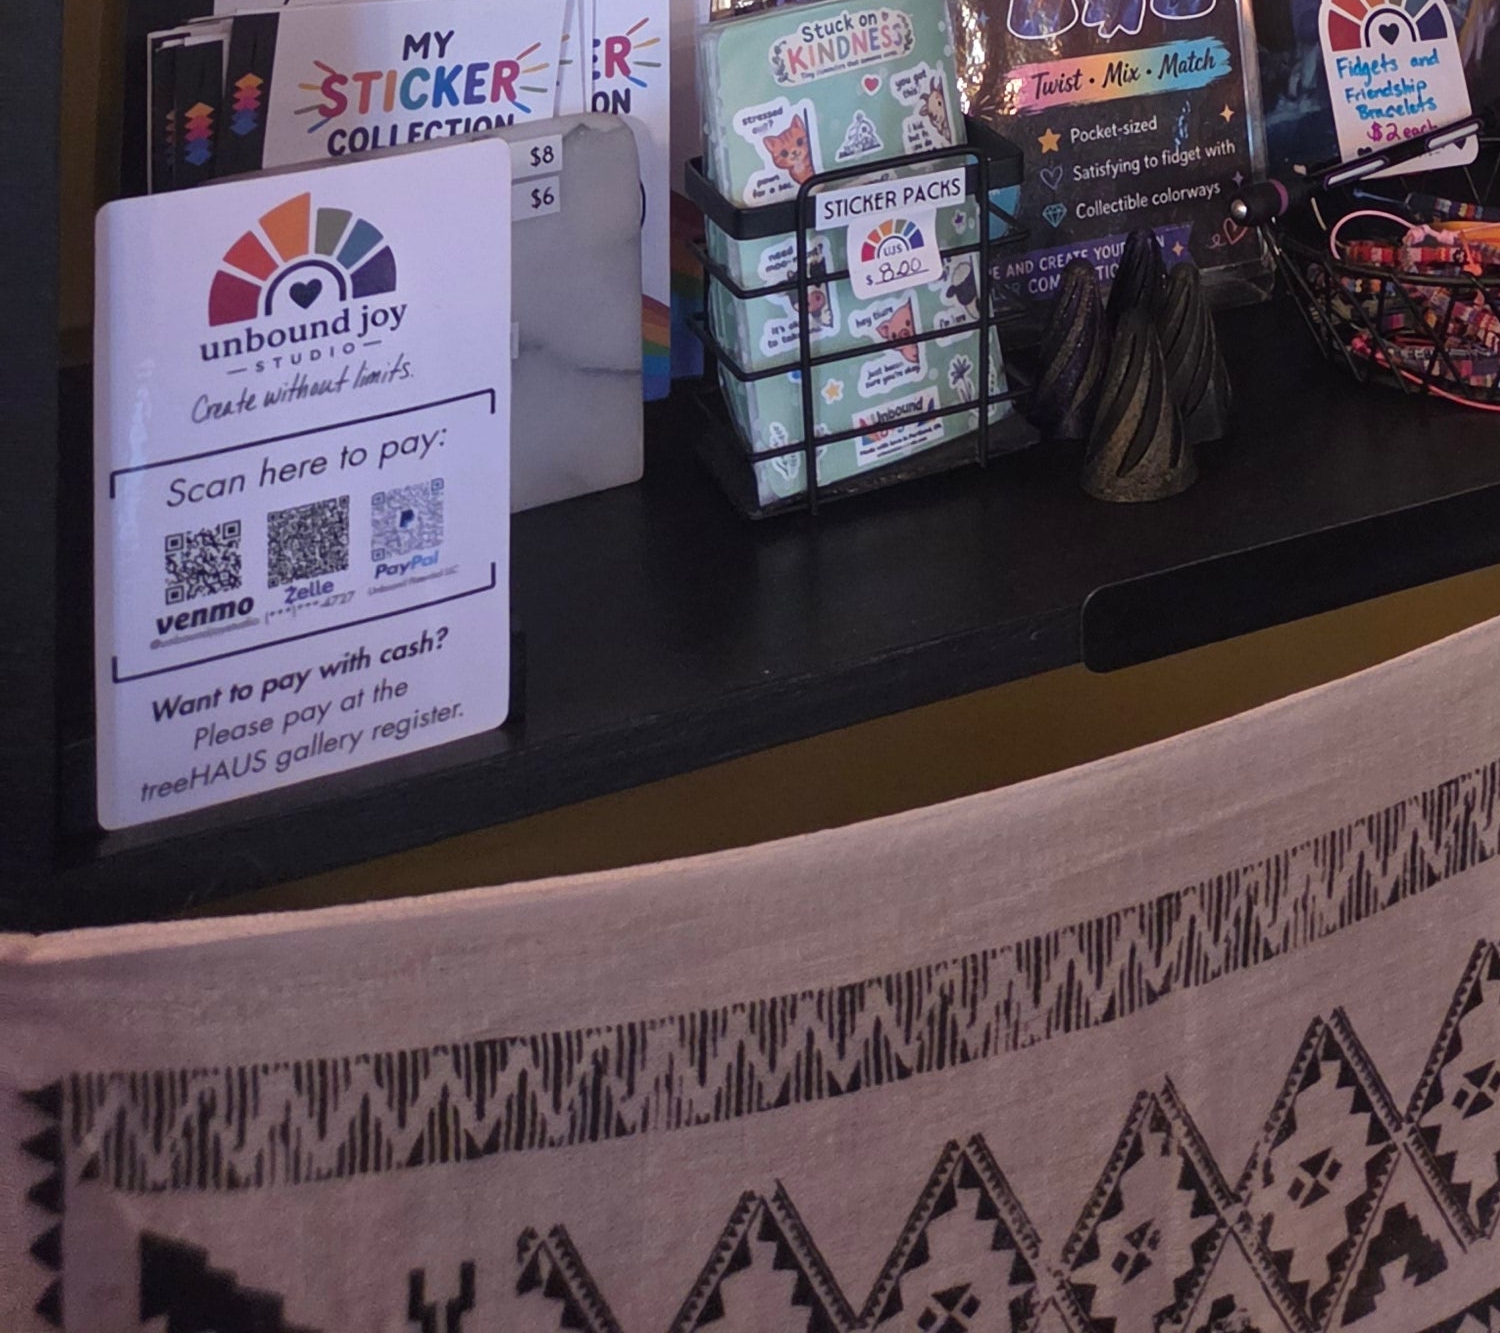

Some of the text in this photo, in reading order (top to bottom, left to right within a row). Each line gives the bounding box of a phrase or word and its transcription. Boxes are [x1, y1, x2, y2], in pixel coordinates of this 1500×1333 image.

[402, 30, 455, 62] MY
[801, 13, 877, 43] Stuck on
[787, 22, 903, 75] KINDNESS
[1336, 47, 1440, 87] Fidgets and
[316, 59, 522, 119] STICKER
[1032, 47, 1216, 101] Twist Mix Match
[1345, 78, 1427, 104] Friendship
[1355, 95, 1438, 120] Bracelets
[1070, 115, 1158, 145] Pocket-sized
[1367, 120, 1400, 143] $2
[530, 145, 555, 167] $8
[1072, 139, 1236, 183] Satisfying to fidget with
[531, 186, 555, 209] $6
[823, 178, 962, 220] STICKER PACKS
[1075, 182, 1221, 219] Collectible colorways
[199, 303, 408, 363] unbound joy
[255, 340, 356, 374] STUDIO
[191, 352, 414, 425] Create without limits.
[166, 427, 448, 508] Scan here to pay:
[374, 549, 440, 580] PayPal
[284, 578, 335, 605] Zelle
[155, 595, 255, 635] venmo
[152, 627, 449, 723] Want to pay with cash?
[193, 677, 408, 751] Please pay at the
[140, 702, 464, 803] treeHAUS gallery register.
